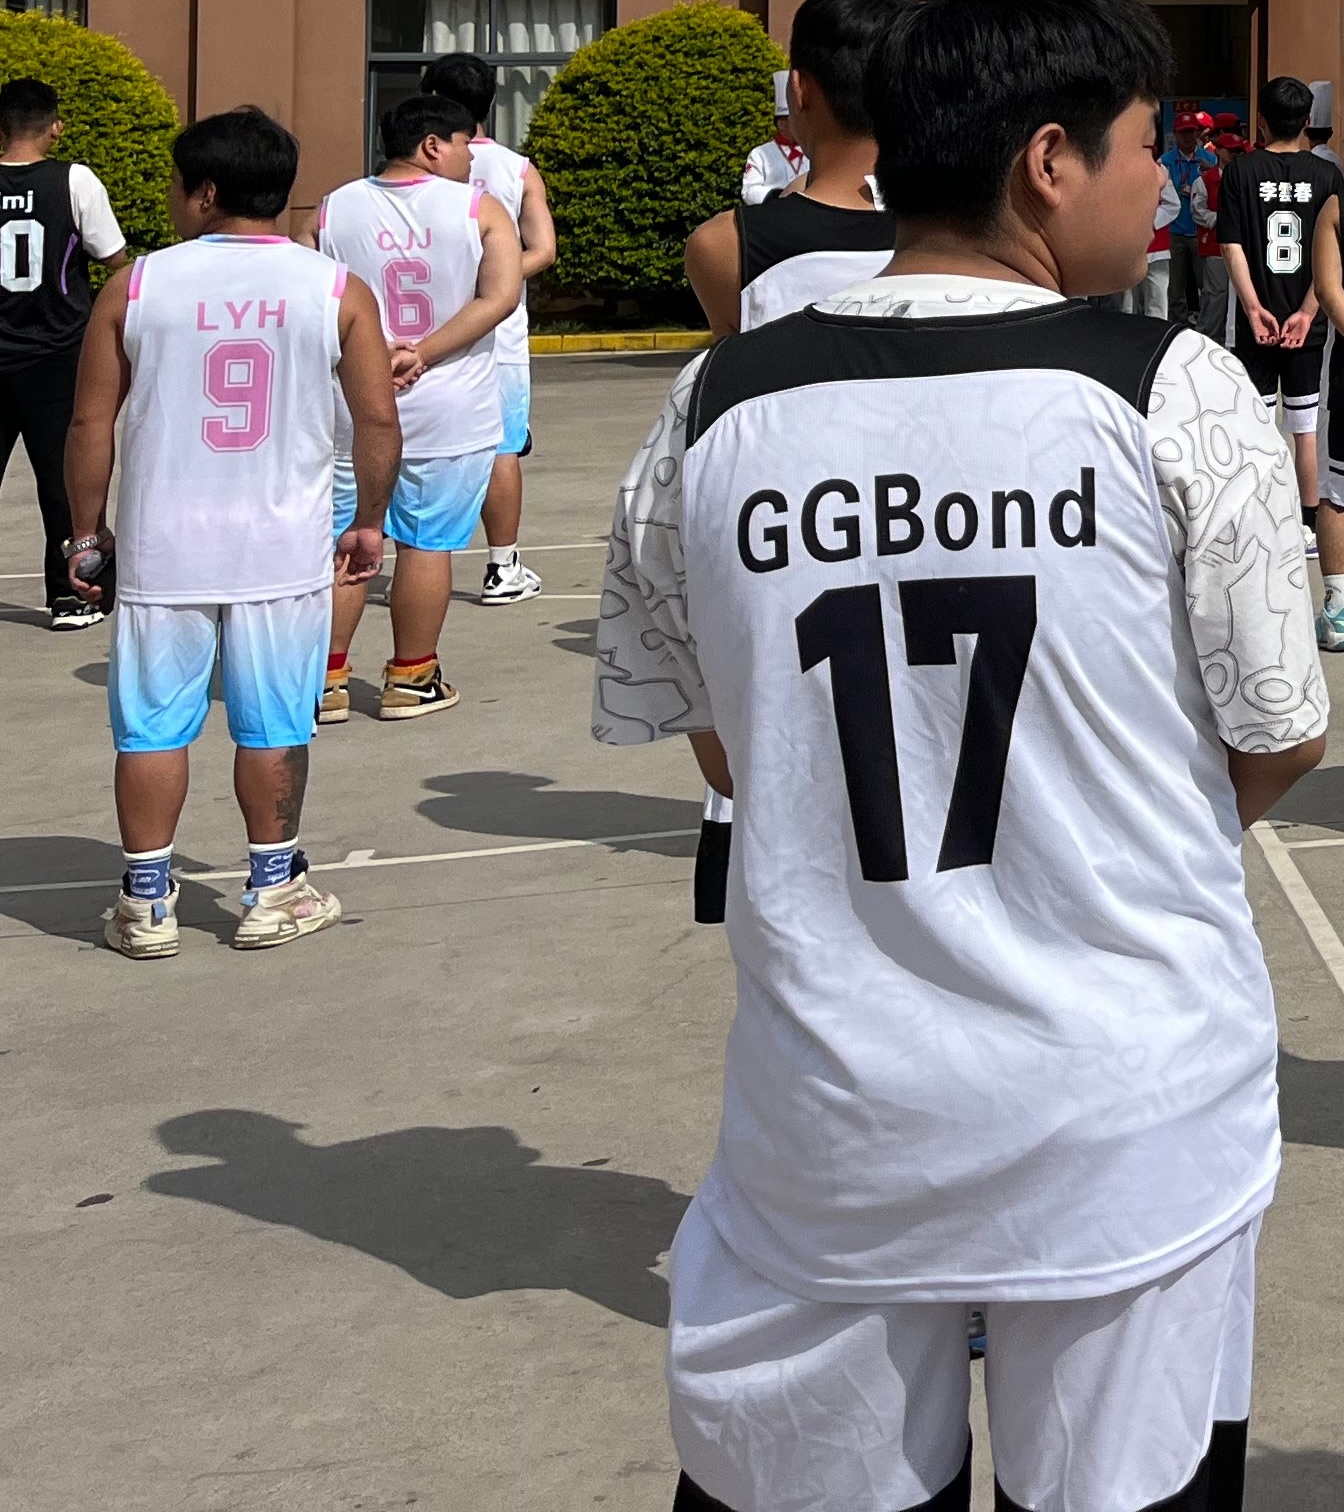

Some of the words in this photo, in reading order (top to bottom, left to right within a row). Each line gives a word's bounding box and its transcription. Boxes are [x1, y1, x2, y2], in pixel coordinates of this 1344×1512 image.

[1266, 210, 1303, 274] 8
[196, 299, 287, 332] LYH
[381, 257, 435, 339] 6
[201, 337, 275, 453] 9
[737, 466, 1097, 574] GGBond
[795, 574, 1038, 883] 17
